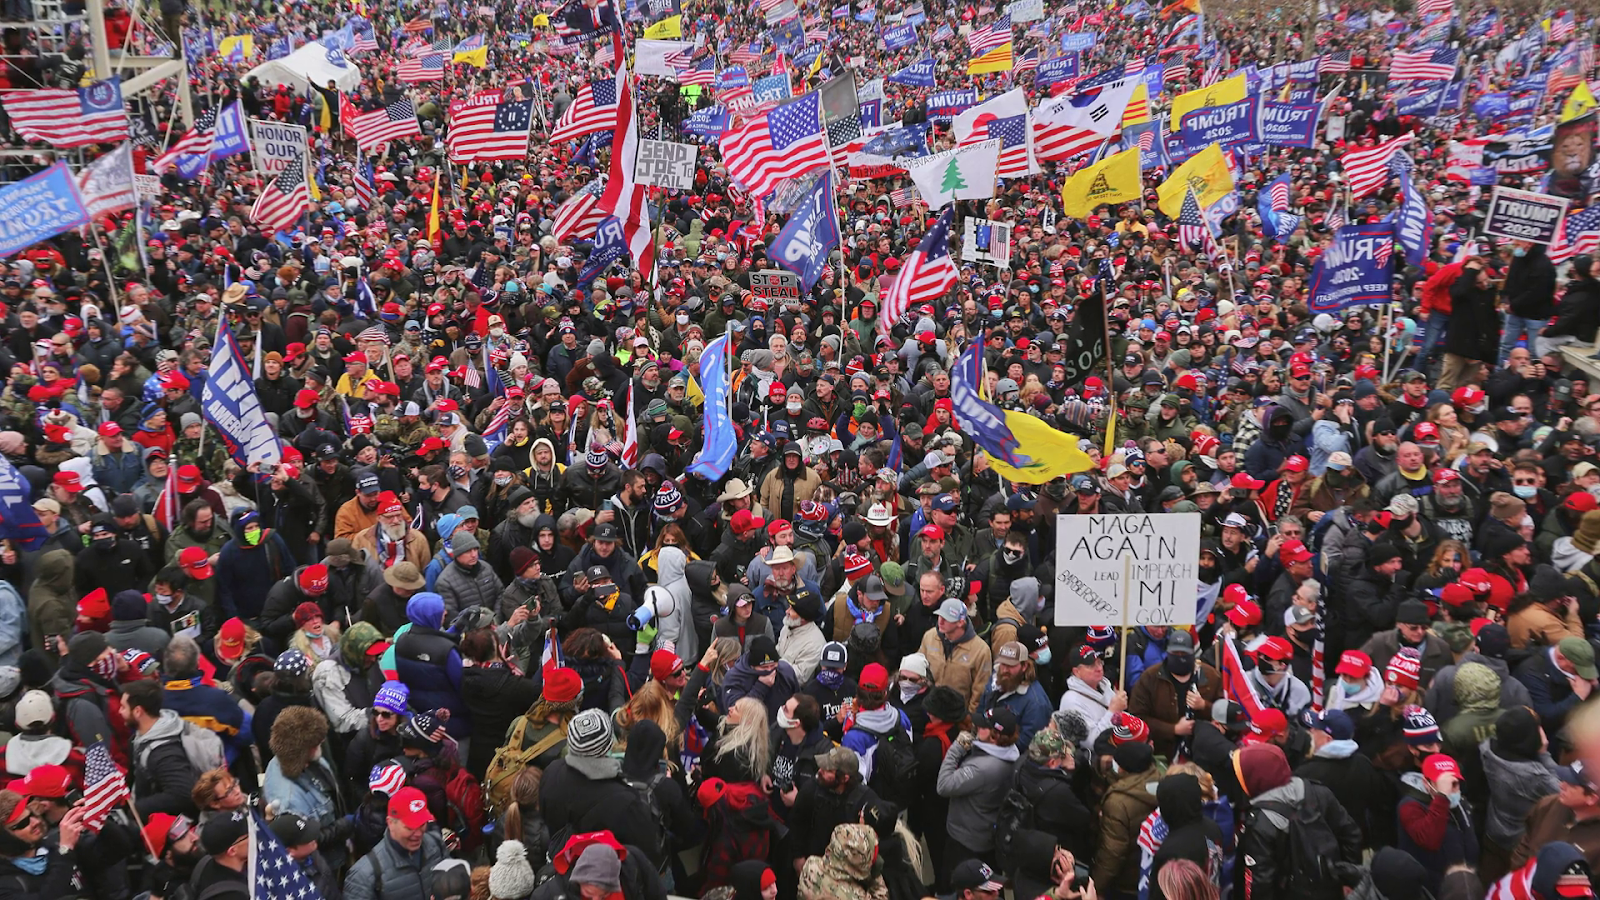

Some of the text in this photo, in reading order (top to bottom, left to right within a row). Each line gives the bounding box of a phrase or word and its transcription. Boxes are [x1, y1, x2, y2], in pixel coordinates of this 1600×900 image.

[257, 125, 303, 144] HONOR
[265, 143, 297, 157] OUR
[642, 140, 688, 162] SEND
[263, 157, 292, 172] VOT
[638, 158, 693, 178] JOE TO
[650, 173, 685, 188] JAIL
[1498, 200, 1559, 223] TRUMP
[1503, 222, 1541, 237] 2020
[752, 274, 789, 286] STOP
[752, 287, 799, 298] STEAL
[1066, 338, 1103, 379] SOG
[655, 490, 680, 505] TRUM
[1089, 515, 1156, 535] MAGA
[1070, 536, 1177, 561] AGAIN
[1094, 571, 1120, 581] LEAD
[1131, 563, 1192, 580] IMPEACH
[1057, 569, 1119, 618] BARBERSHOP?
[1139, 580, 1176, 606] MI
[1135, 608, 1174, 625] GOV.
[823, 703, 841, 715] Tru
[1408, 713, 1437, 728] TRU
